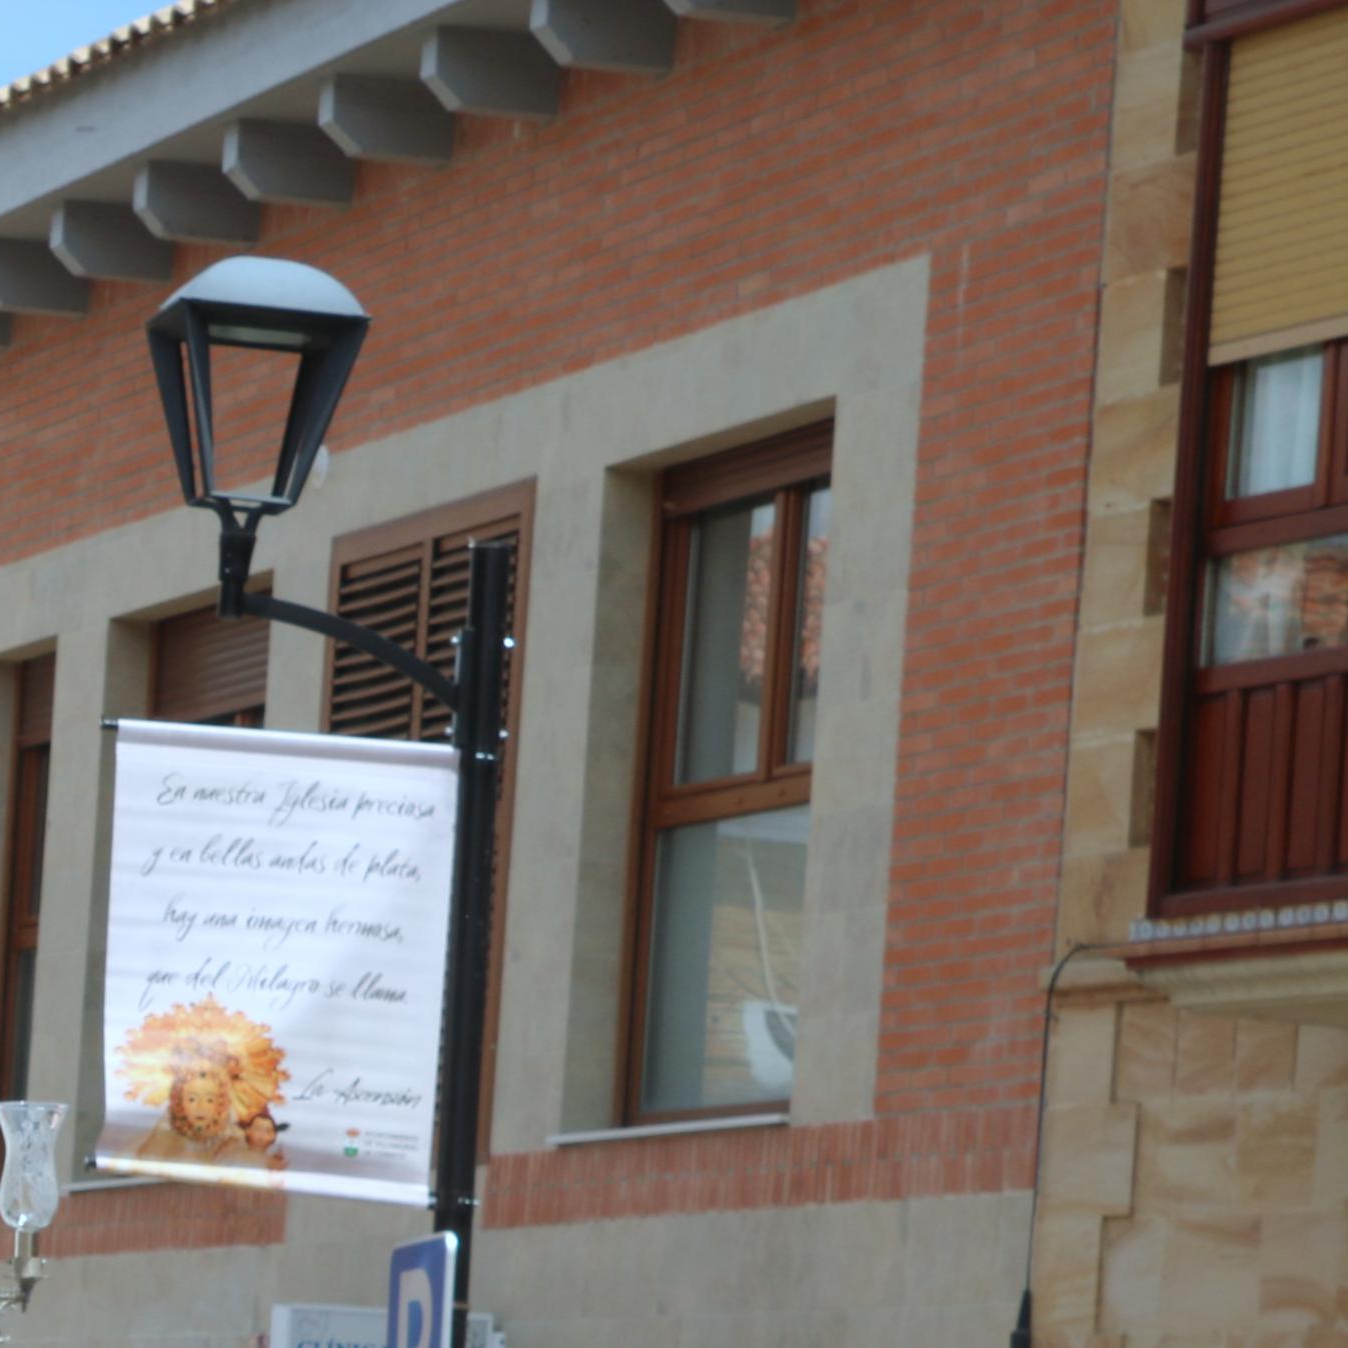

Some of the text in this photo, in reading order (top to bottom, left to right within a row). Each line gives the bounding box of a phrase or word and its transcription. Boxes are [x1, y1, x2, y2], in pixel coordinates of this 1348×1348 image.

[156, 772, 436, 828] En nuestra Iglesia preciosa
[140, 846, 163, 877] y
[169, 848, 193, 862] en
[198, 833, 262, 870] bellas
[269, 841, 326, 875] andas
[333, 843, 357, 876] de
[162, 893, 199, 941] hay
[201, 911, 238, 928] una
[245, 908, 319, 951] imagen
[137, 968, 182, 1011] que
[184, 956, 232, 992] del
[324, 981, 347, 998] se
[351, 970, 408, 1003] llama
